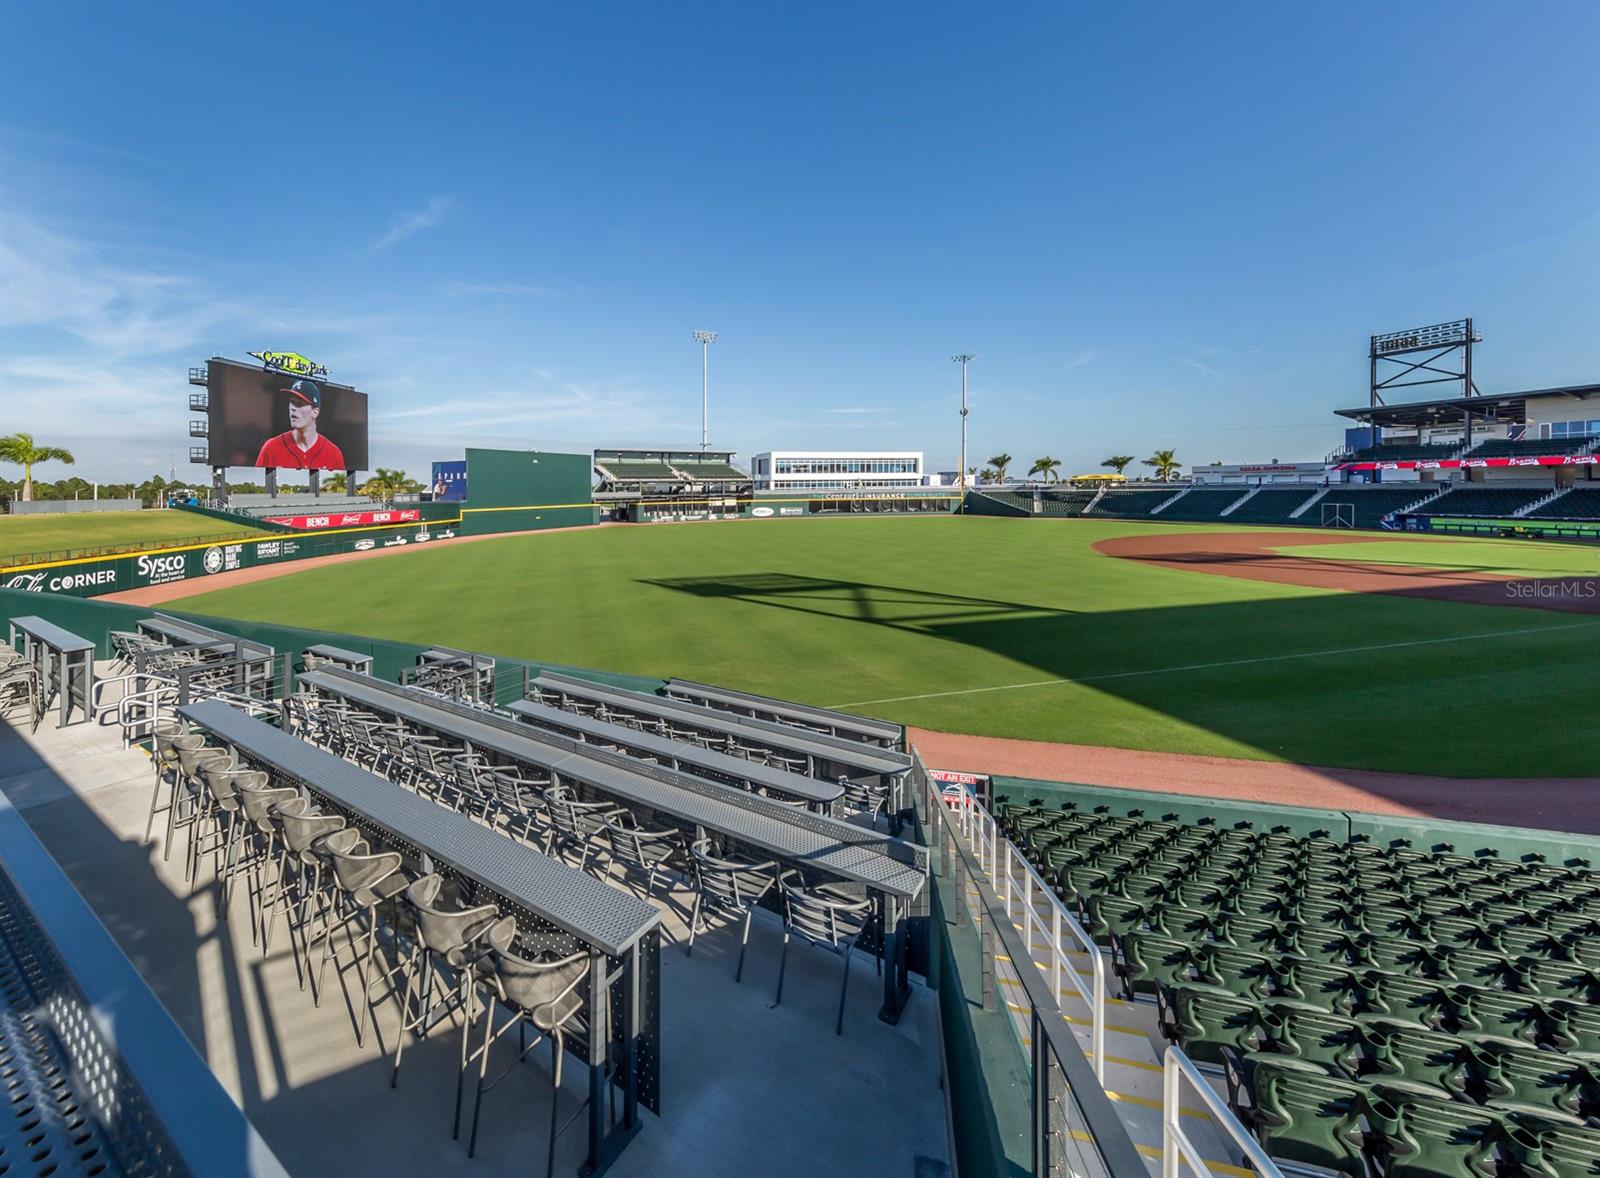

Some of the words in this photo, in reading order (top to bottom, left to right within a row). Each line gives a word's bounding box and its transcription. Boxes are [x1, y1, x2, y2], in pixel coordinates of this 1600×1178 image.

[310, 361, 327, 376] Park
[305, 516, 329, 527] BENCH
[373, 511, 391, 522] BENCH
[138, 555, 184, 577] Sysco
[50, 570, 116, 591] CORNER
[947, 773, 958, 781] AN
[960, 775, 975, 783] EXIT
